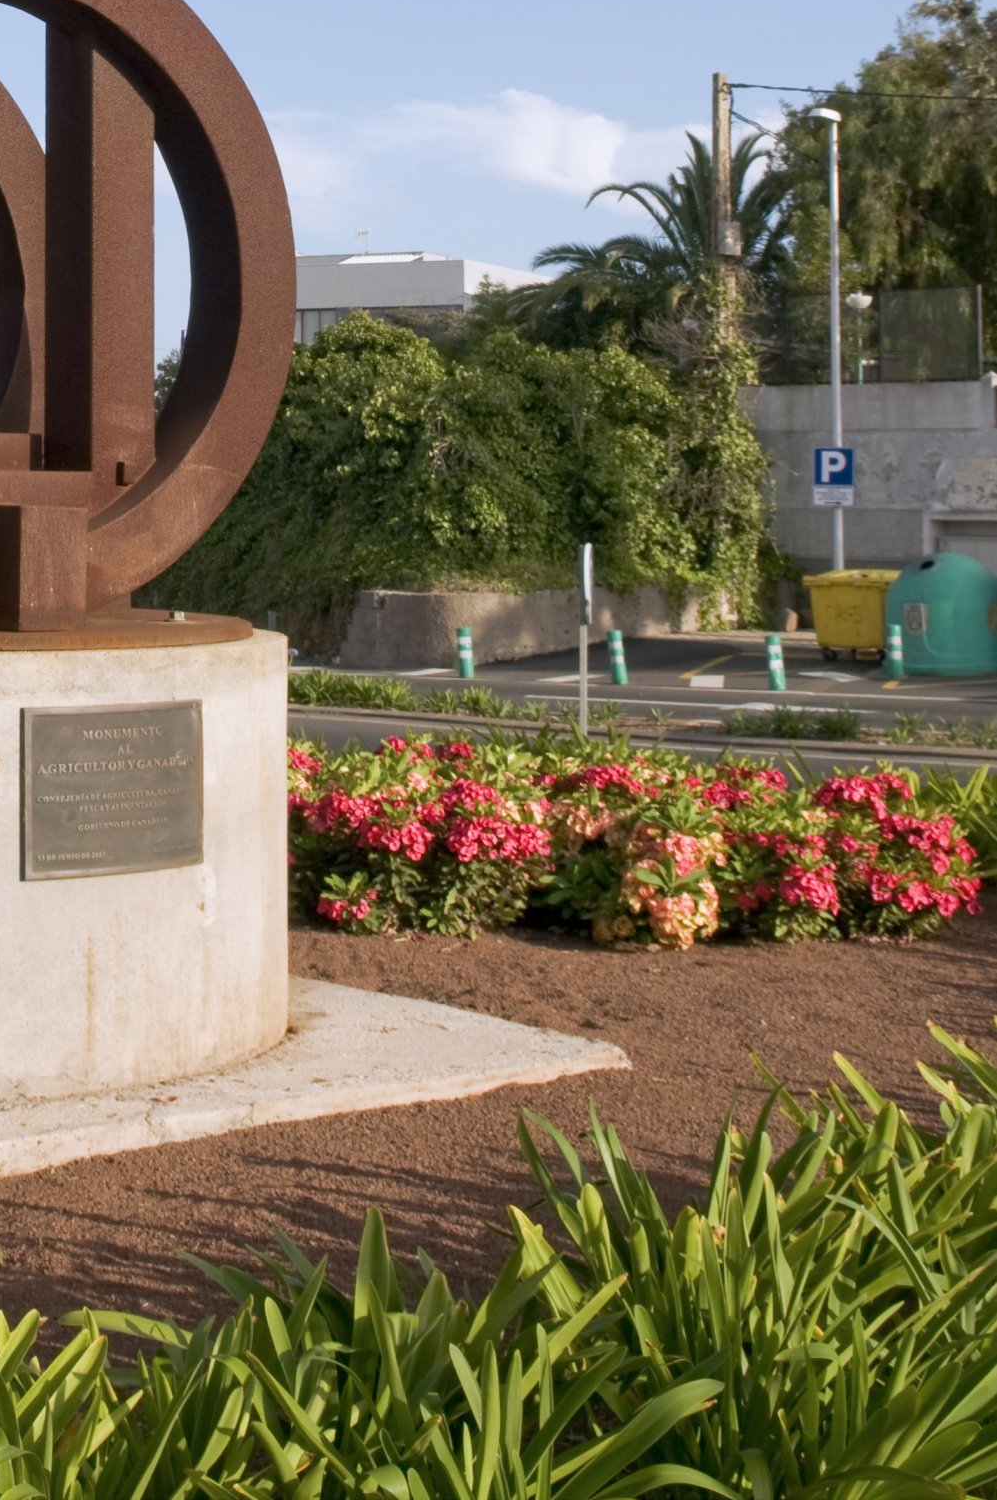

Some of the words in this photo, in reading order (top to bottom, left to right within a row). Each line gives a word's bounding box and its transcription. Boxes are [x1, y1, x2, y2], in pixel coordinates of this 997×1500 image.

[821, 451, 846, 482] P
[82, 725, 163, 741] MONUMENTO
[117, 744, 133, 756] AL
[37, 761, 126, 775] AGRICULTOR
[126, 760, 135, 771] Y
[78, 820, 120, 832] GOBIERNO
